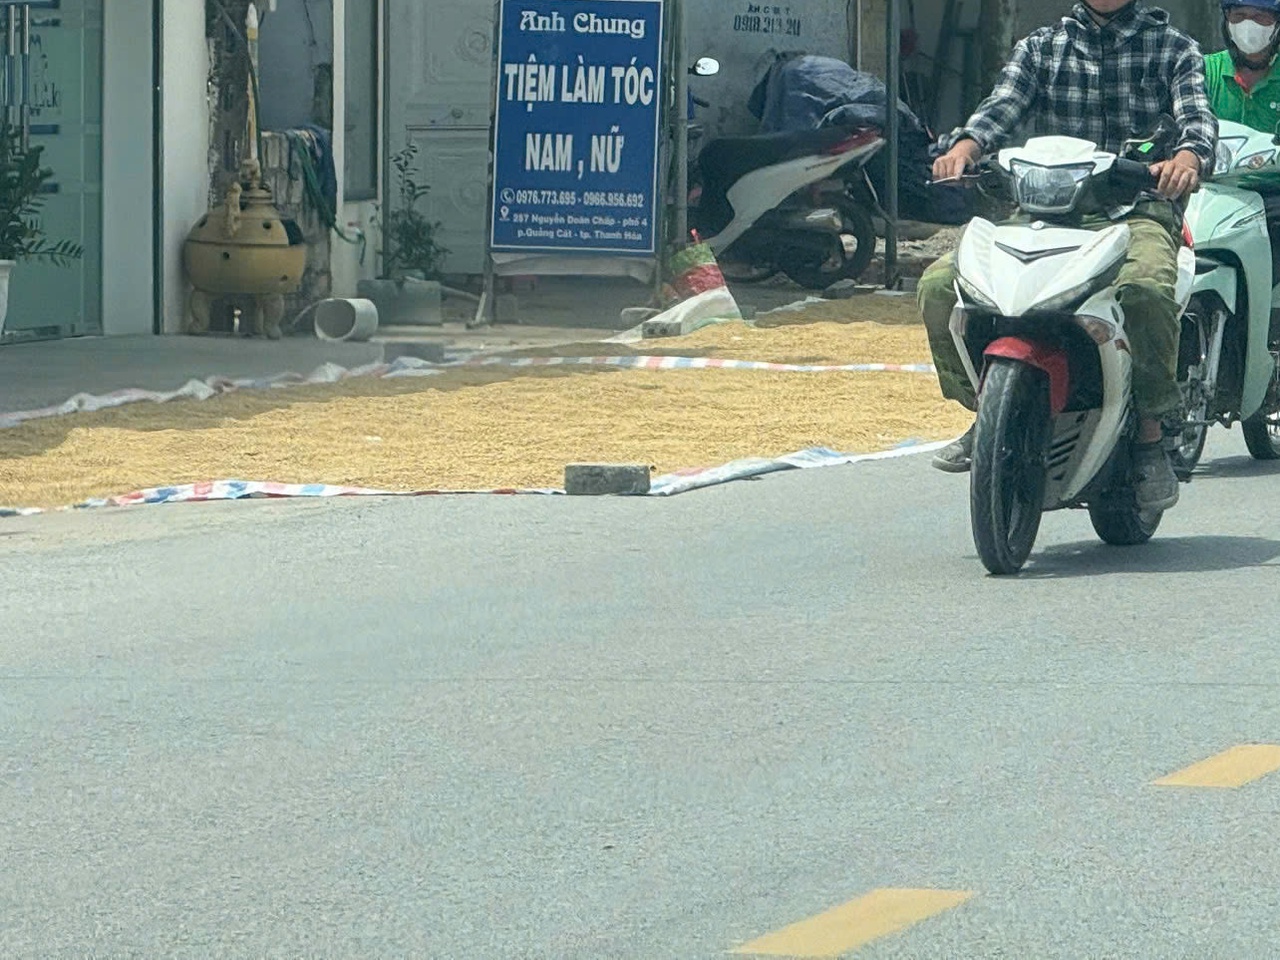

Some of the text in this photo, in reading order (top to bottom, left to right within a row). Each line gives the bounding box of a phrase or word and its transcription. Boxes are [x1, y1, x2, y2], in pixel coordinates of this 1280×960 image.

[520, 11, 645, 38] Anh Chung
[505, 53, 654, 112] TIỆM LÀM TÓC
[525, 133, 573, 171] NAM
[590, 125, 625, 173] NỮ
